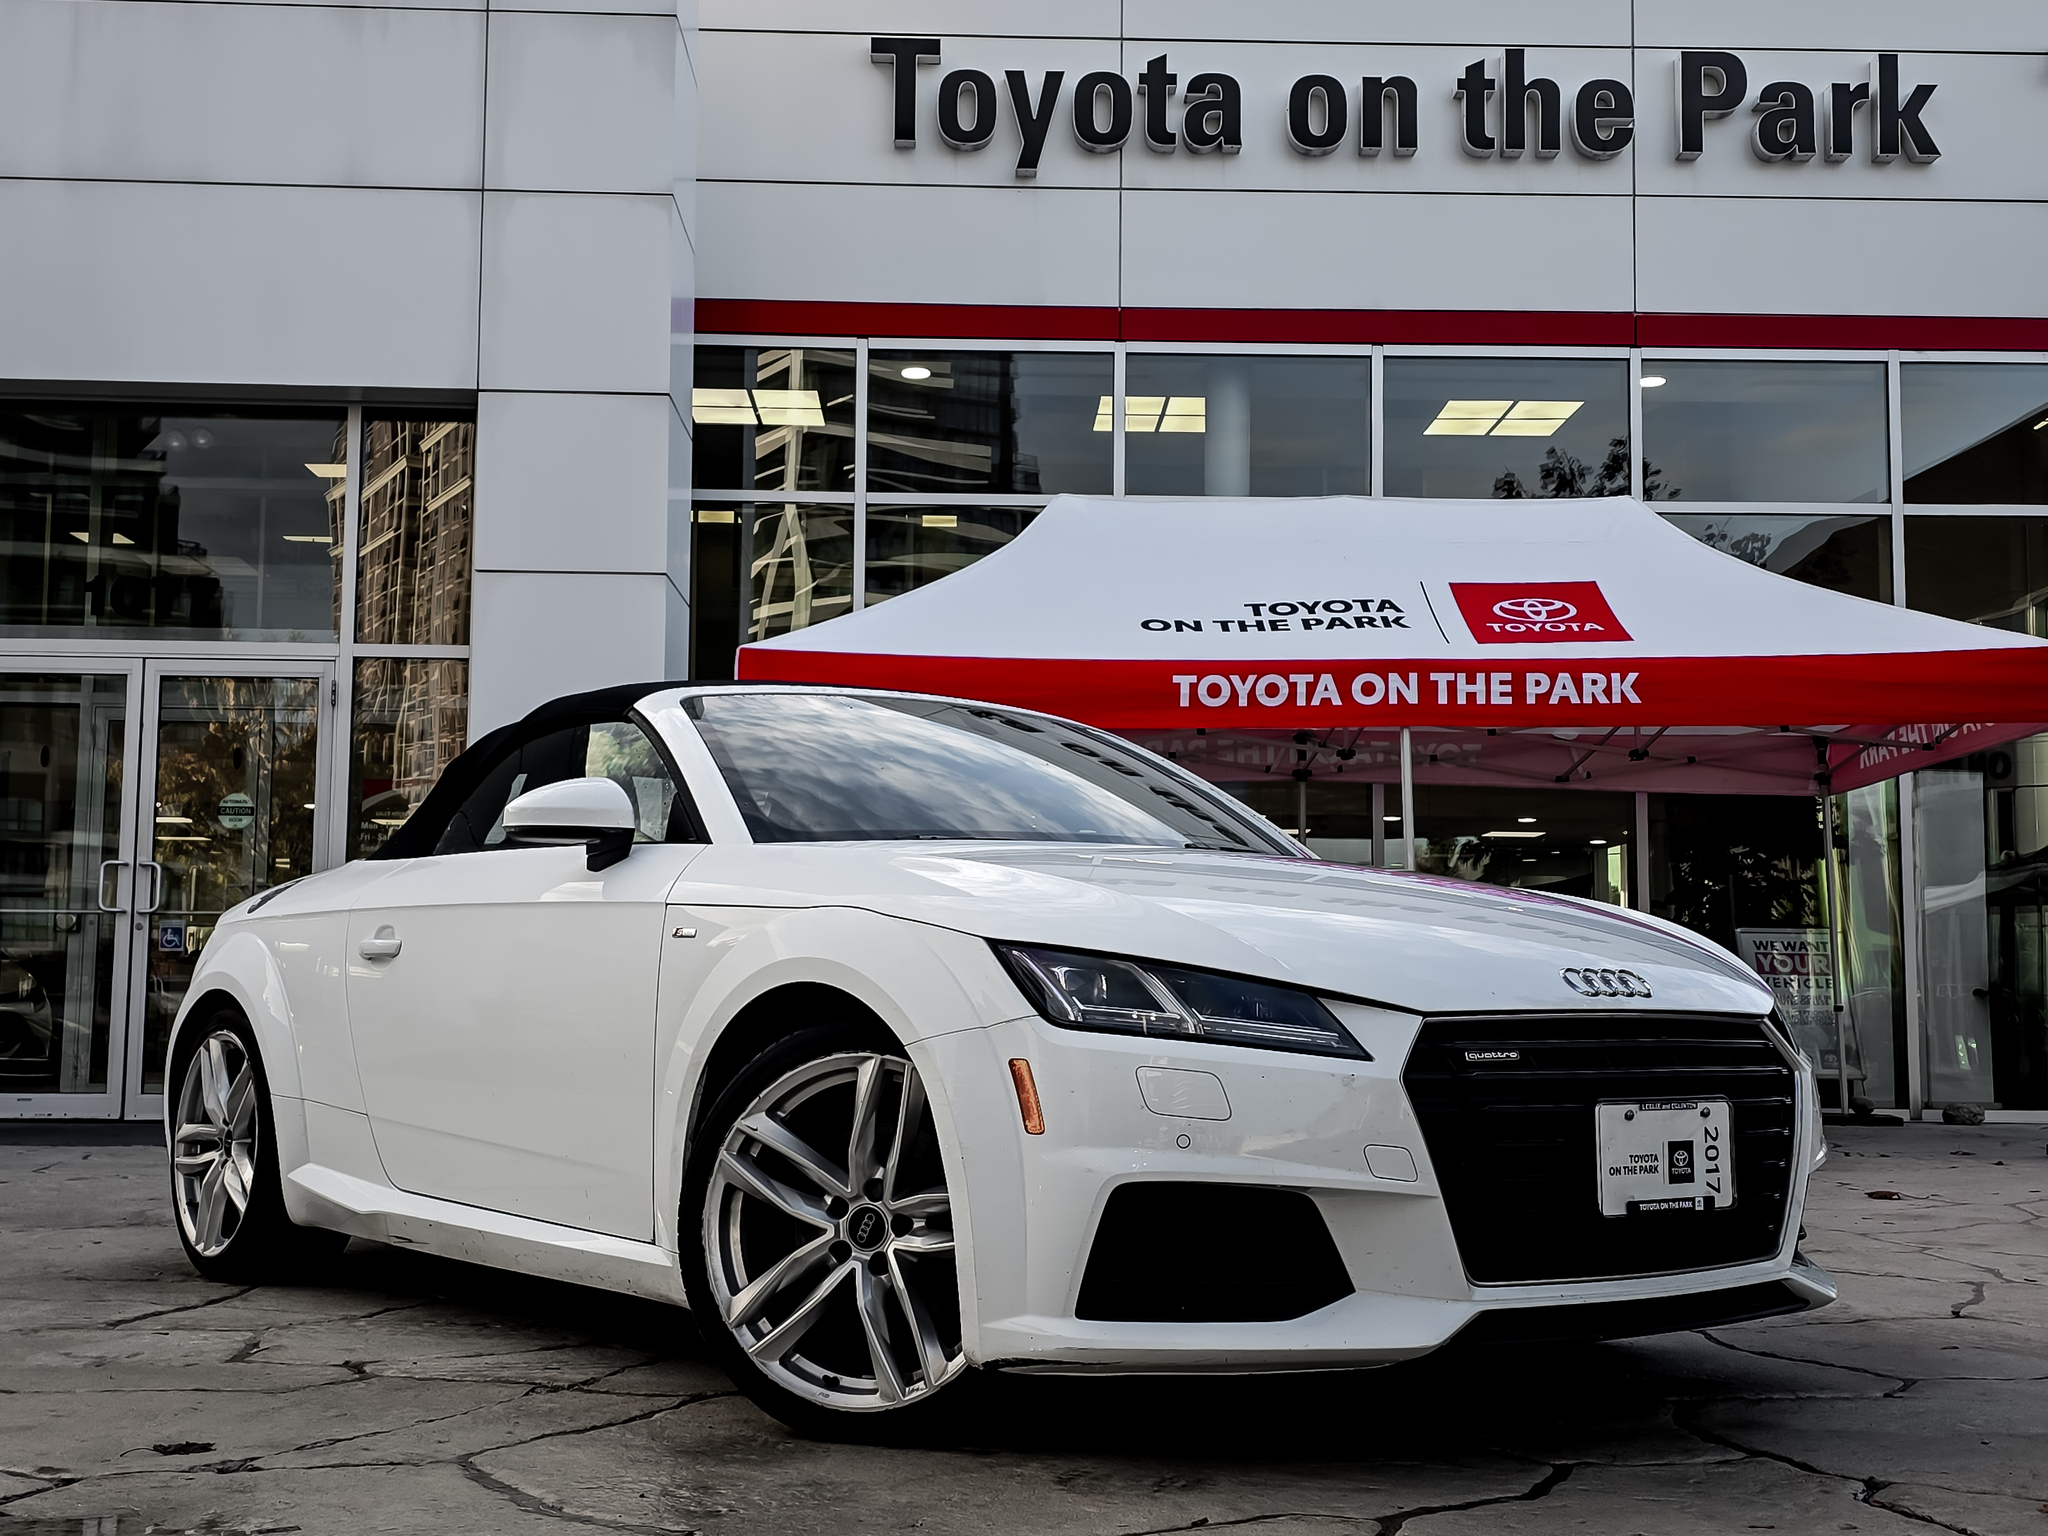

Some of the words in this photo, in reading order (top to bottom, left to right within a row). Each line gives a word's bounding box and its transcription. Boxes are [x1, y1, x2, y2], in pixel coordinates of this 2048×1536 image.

[869, 36, 1242, 178] Toyota
[1285, 73, 1418, 157] on
[1453, 48, 1636, 162] the
[1673, 50, 1943, 165] Park
[1243, 599, 1405, 617] TOYOTA
[1140, 618, 1204, 633] ON
[1212, 617, 1292, 633] THE
[1300, 614, 1412, 631] PARK
[1485, 622, 1605, 633] TOYOTA
[1172, 673, 1343, 708] TOYOTA
[1351, 672, 1418, 706] ON
[1429, 672, 1513, 705] THE
[1525, 671, 1642, 705] PARK
[220, 807, 252, 815] CAUTION
[360, 821, 379, 830] Mon
[1753, 940, 1780, 951] WE
[1780, 940, 1829, 953] WANT
[1756, 953, 1831, 973] YOUR
[1468, 1051, 1518, 1060] quattro
[1628, 1153, 1659, 1164] TOYOTA
[1704, 1126, 1721, 1194] 2017
[1608, 1166, 1621, 1177] ON
[1622, 1165, 1638, 1176] THE
[1638, 1164, 1659, 1175] PARK
[1671, 1167, 1692, 1175] TOYOTA
